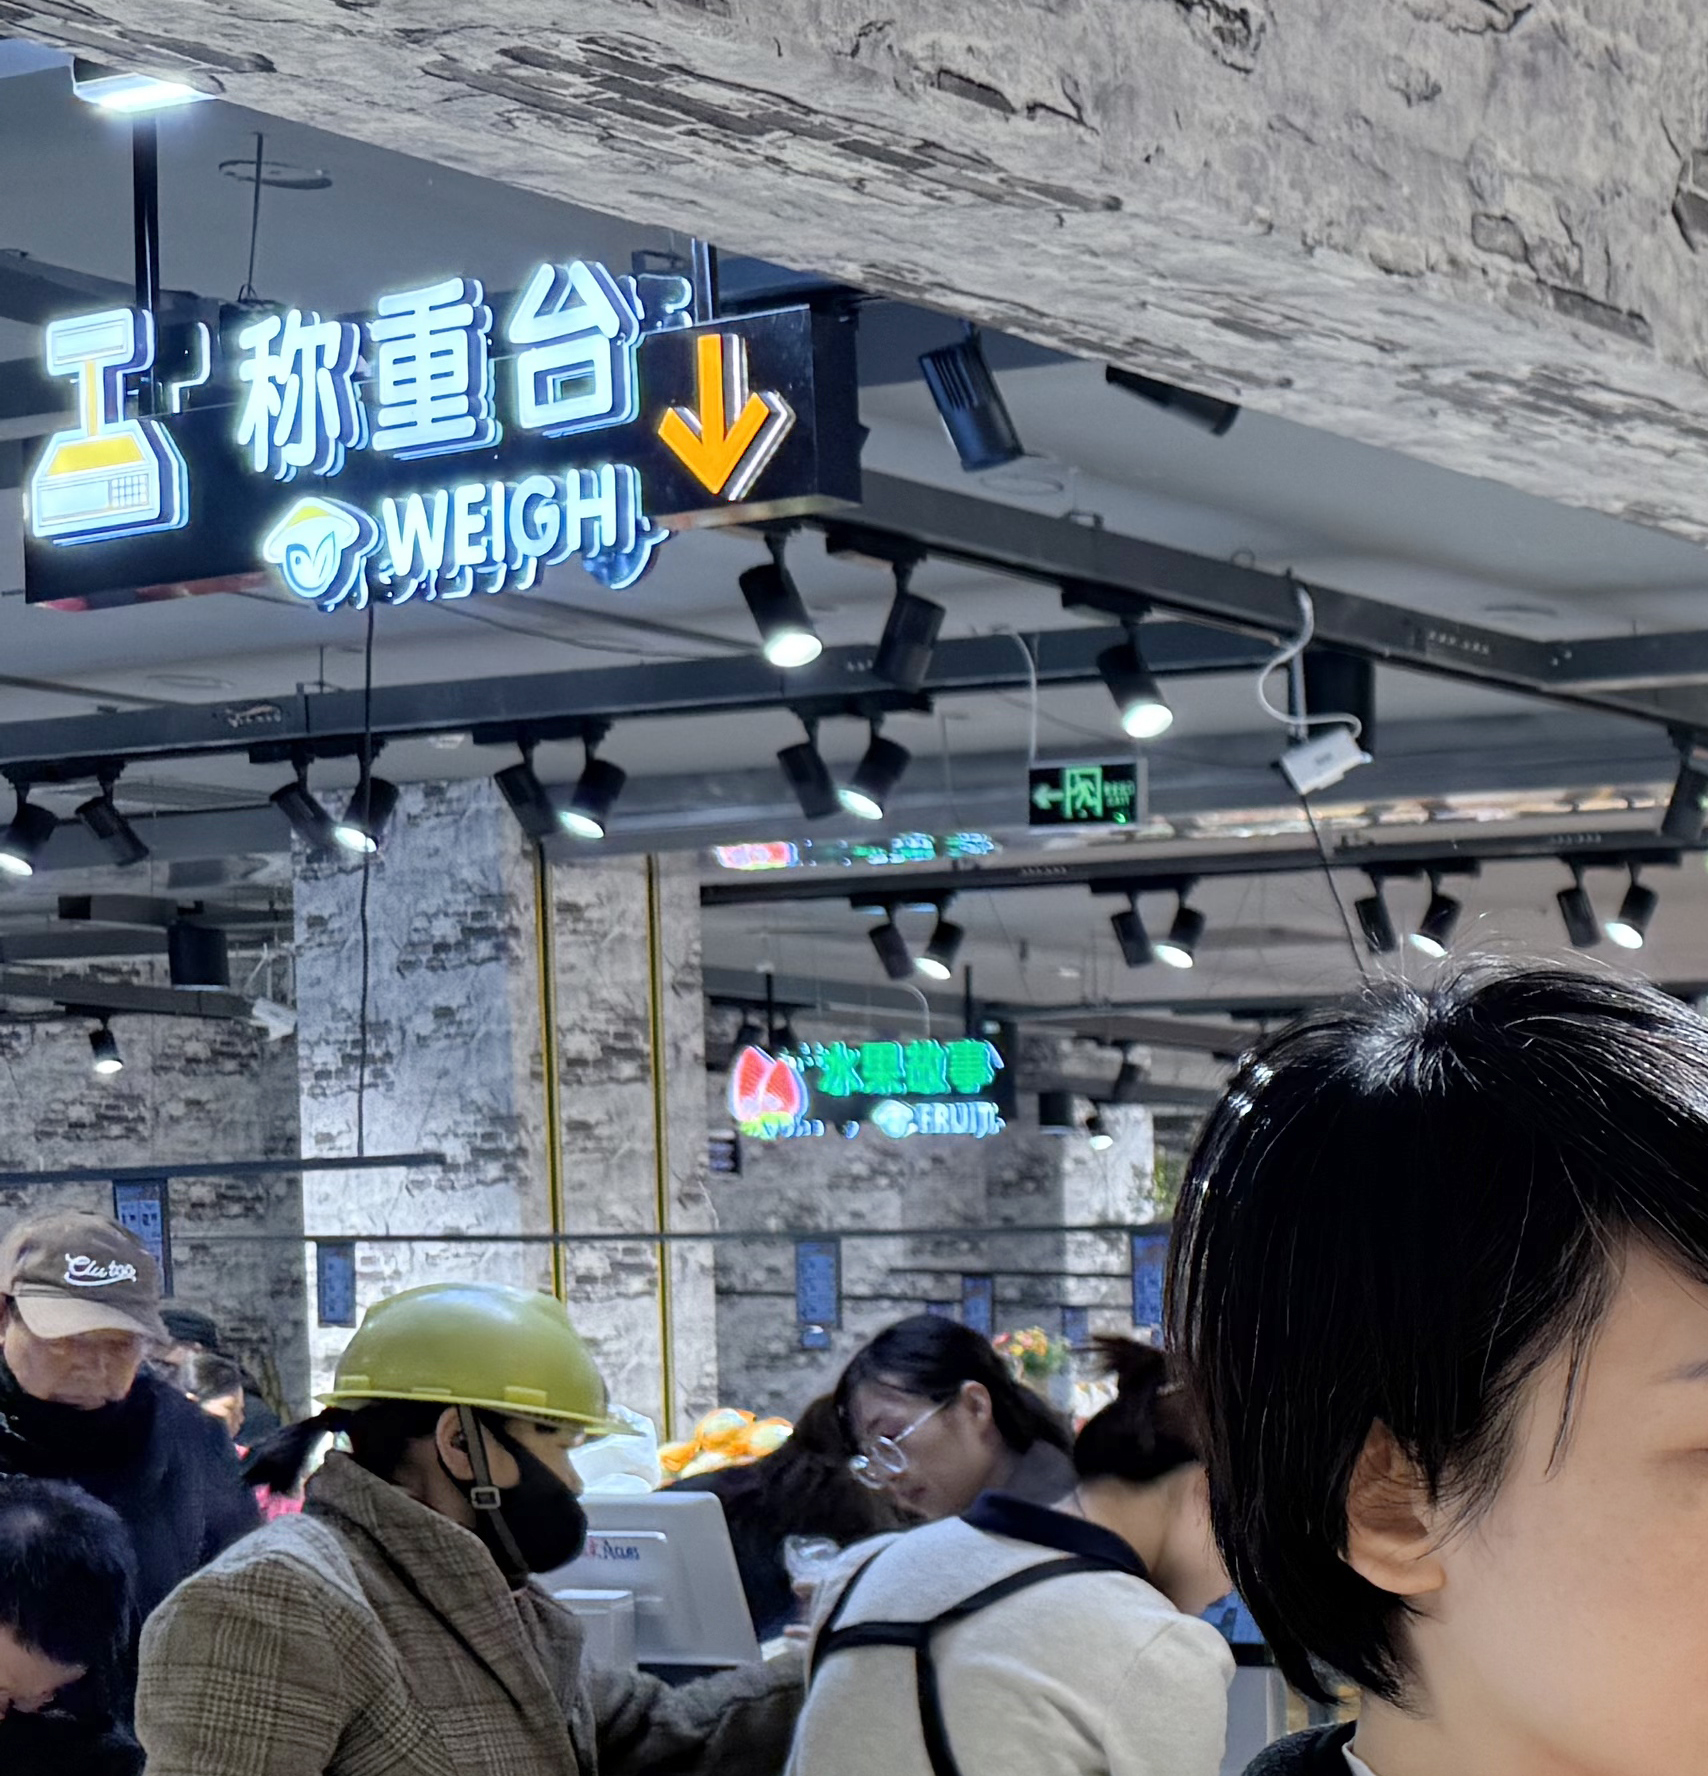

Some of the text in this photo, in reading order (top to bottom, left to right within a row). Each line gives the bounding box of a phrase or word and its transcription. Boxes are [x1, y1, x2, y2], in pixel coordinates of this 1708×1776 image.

[236, 260, 628, 474] 称重台
[381, 462, 620, 578] WEIGH
[915, 1101, 998, 1134] FRUIT
